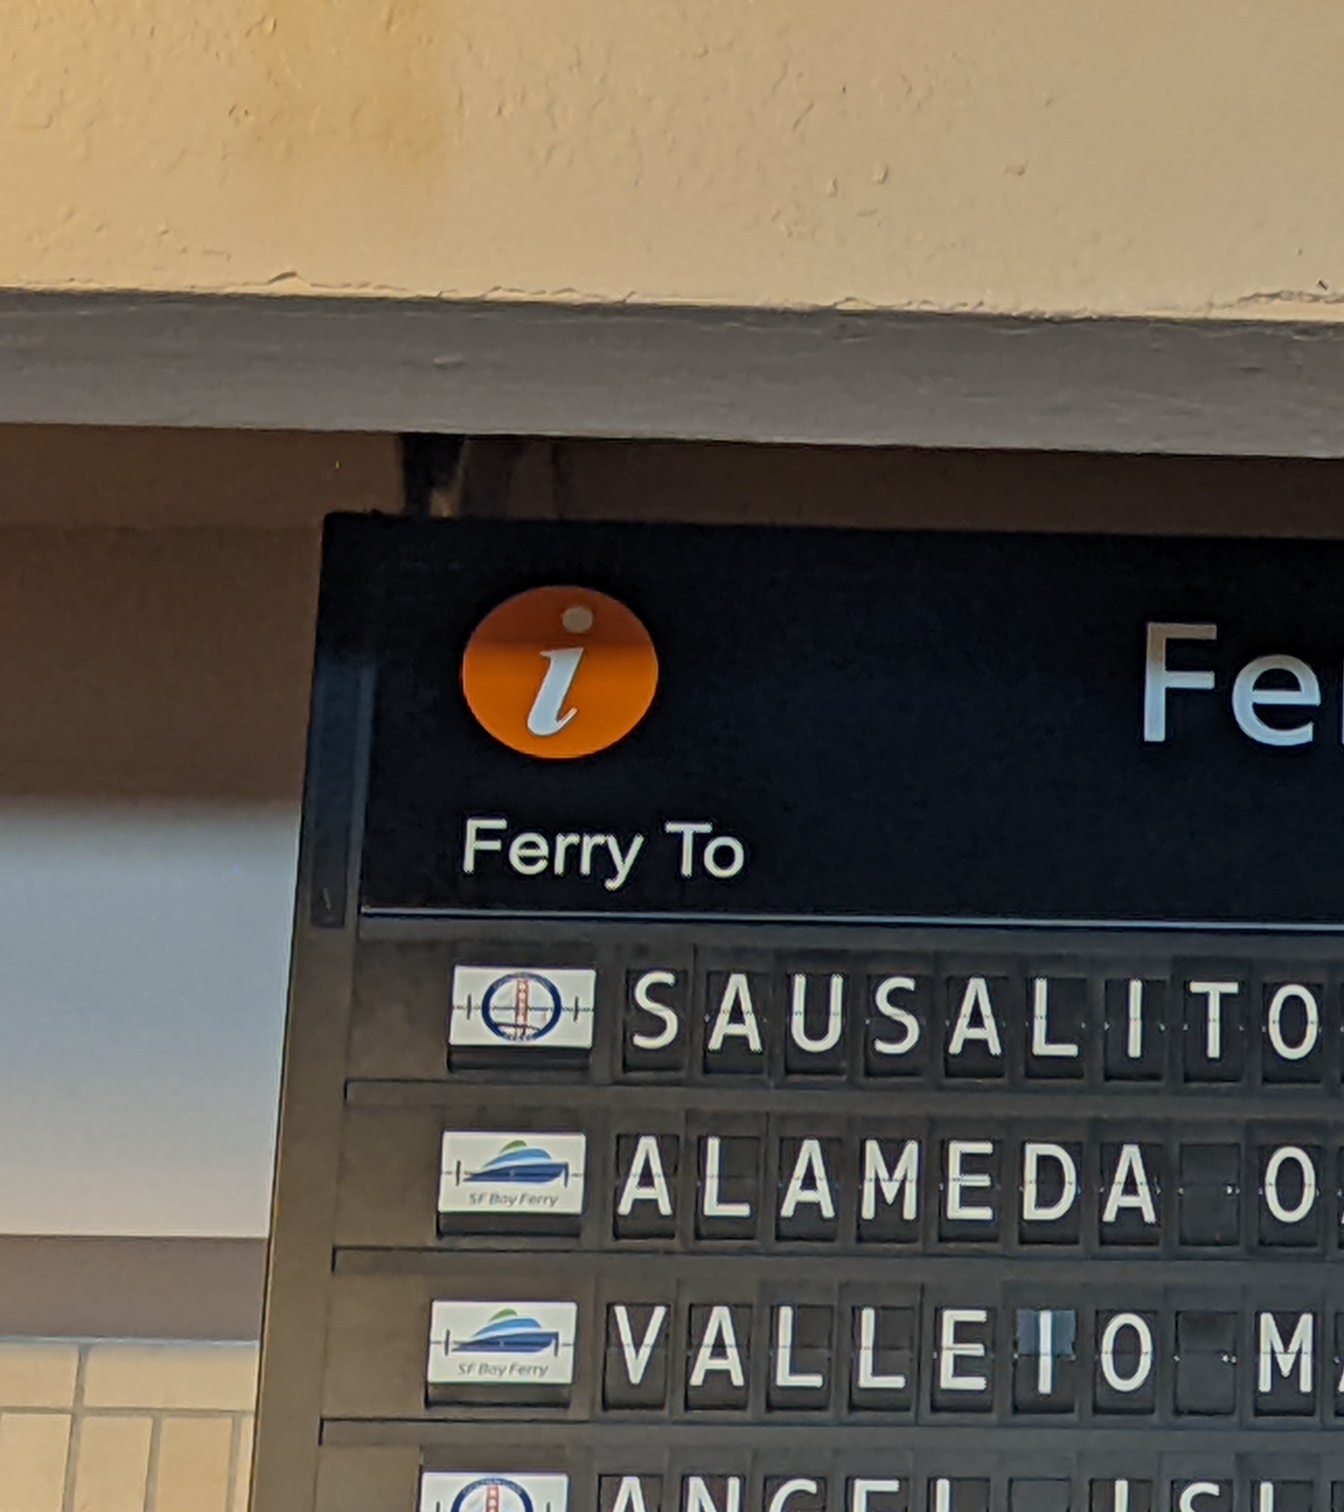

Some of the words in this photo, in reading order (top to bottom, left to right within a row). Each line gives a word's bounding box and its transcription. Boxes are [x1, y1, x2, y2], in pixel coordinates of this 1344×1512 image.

[462, 818, 645, 890] Ferry
[664, 821, 745, 878] To
[632, 970, 1319, 1060] SAUSALITO
[469, 1192, 487, 1206] SF
[489, 1193, 517, 1207] Bay
[519, 1193, 559, 1207] Ferry
[616, 1135, 1157, 1225] ALAMEDA
[458, 1362, 476, 1376] SF
[478, 1363, 507, 1377] Bay
[508, 1363, 549, 1377] Ferry
